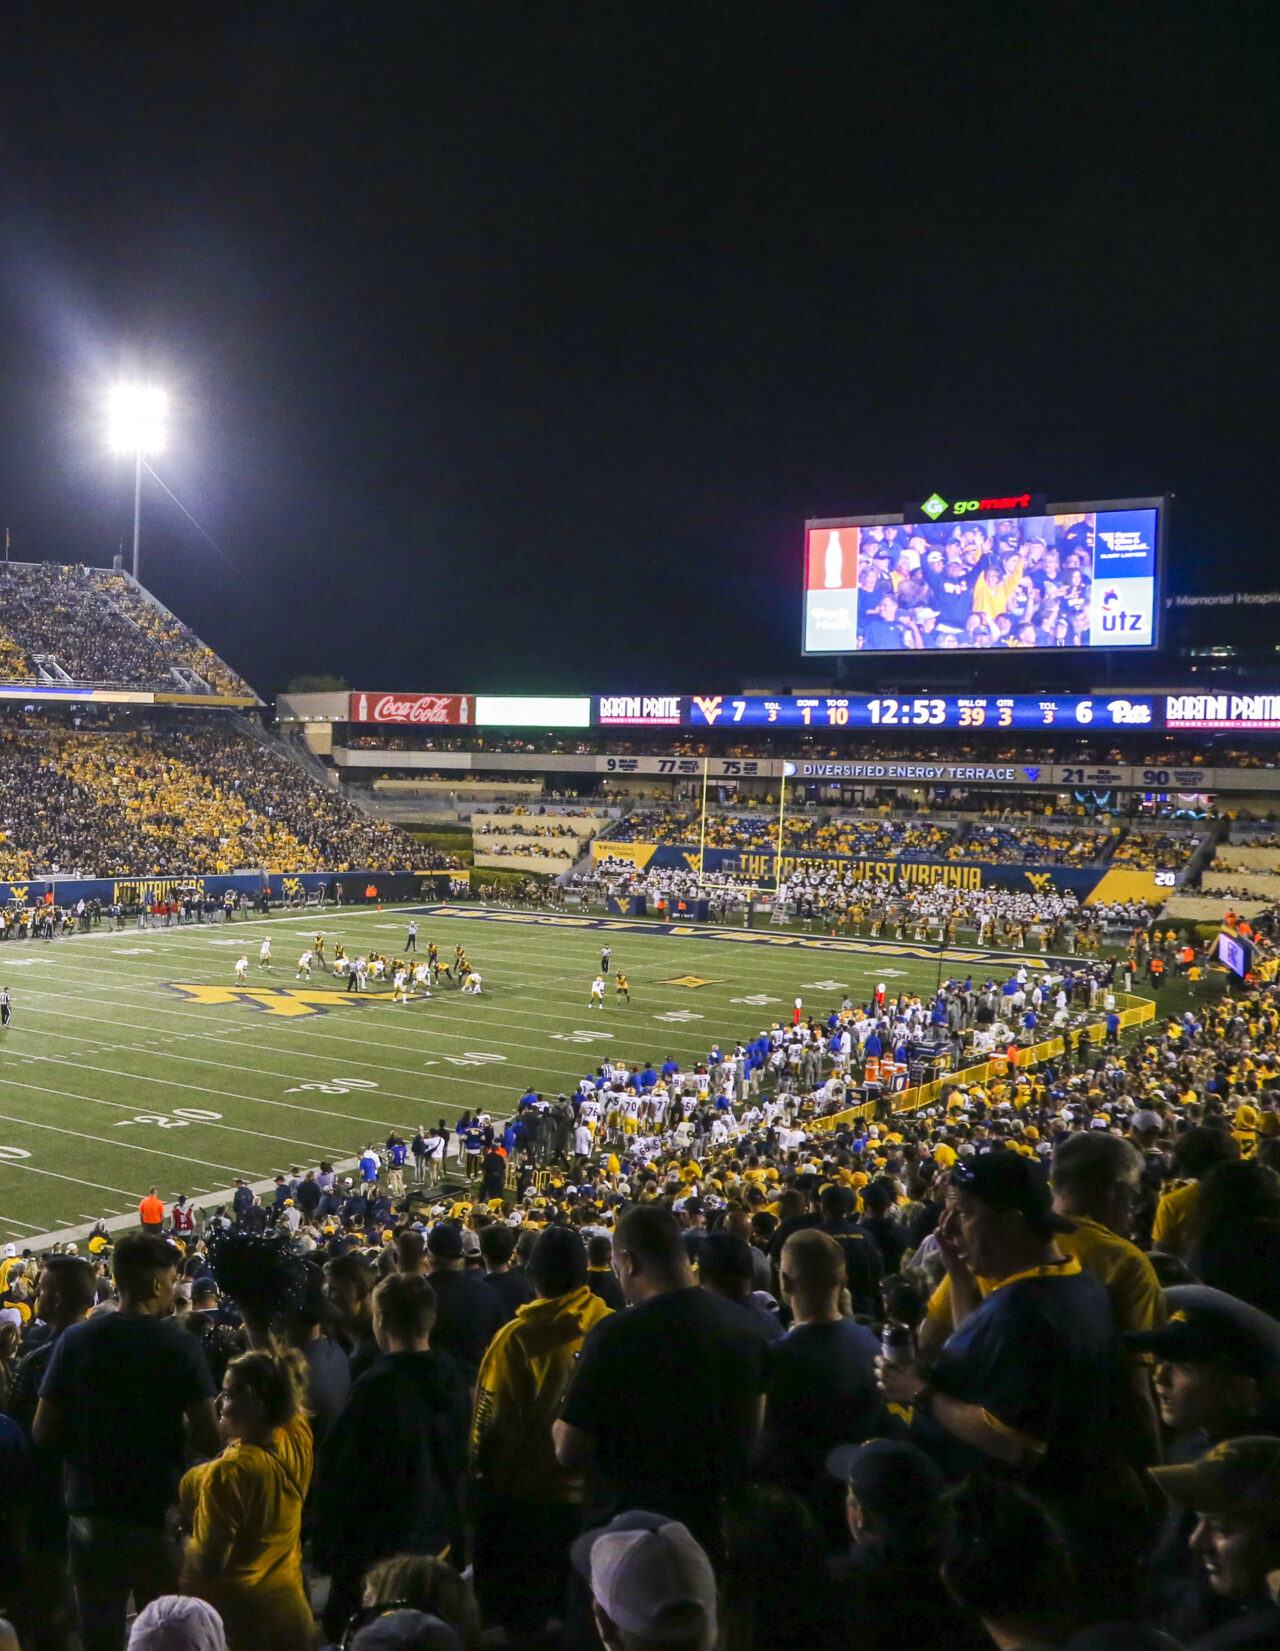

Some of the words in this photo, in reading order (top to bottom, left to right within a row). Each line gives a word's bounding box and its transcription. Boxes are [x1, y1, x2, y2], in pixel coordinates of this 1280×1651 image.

[953, 494, 1031, 515] gomart
[1102, 611, 1143, 632] utz
[374, 695, 453, 722] Coca-Cola
[642, 697, 681, 718] PRIME
[732, 701, 747, 721] 7
[767, 710, 778, 722] 3
[801, 707, 812, 725] 1
[827, 707, 849, 726] 10
[867, 699, 947, 725] 12:53
[1075, 701, 1094, 724] 6
[958, 707, 986, 727] 39
[998, 707, 1013, 727] 3
[1042, 710, 1055, 724] 3
[607, 759, 616, 771] 9
[658, 760, 676, 773] 77
[722, 761, 741, 774] 75
[803, 764, 885, 777] DIVERSIFIED
[888, 766, 945, 778] ENERGY
[947, 767, 1015, 780] TERRACE
[1062, 769, 1084, 783] 21
[1143, 770, 1169, 785] 90
[901, 863, 982, 889] VIRGINIA
[1155, 872, 1176, 886] 20
[427, 906, 663, 930] WEST
[667, 926, 1051, 970] VIRGINIA
[442, 1051, 508, 1067] 40
[299, 1076, 380, 1095] 30
[699, 1078, 708, 1089] 17
[625, 1101, 637, 1112] 70
[657, 1101, 668, 1112] 77
[132, 1107, 224, 1129] 20
